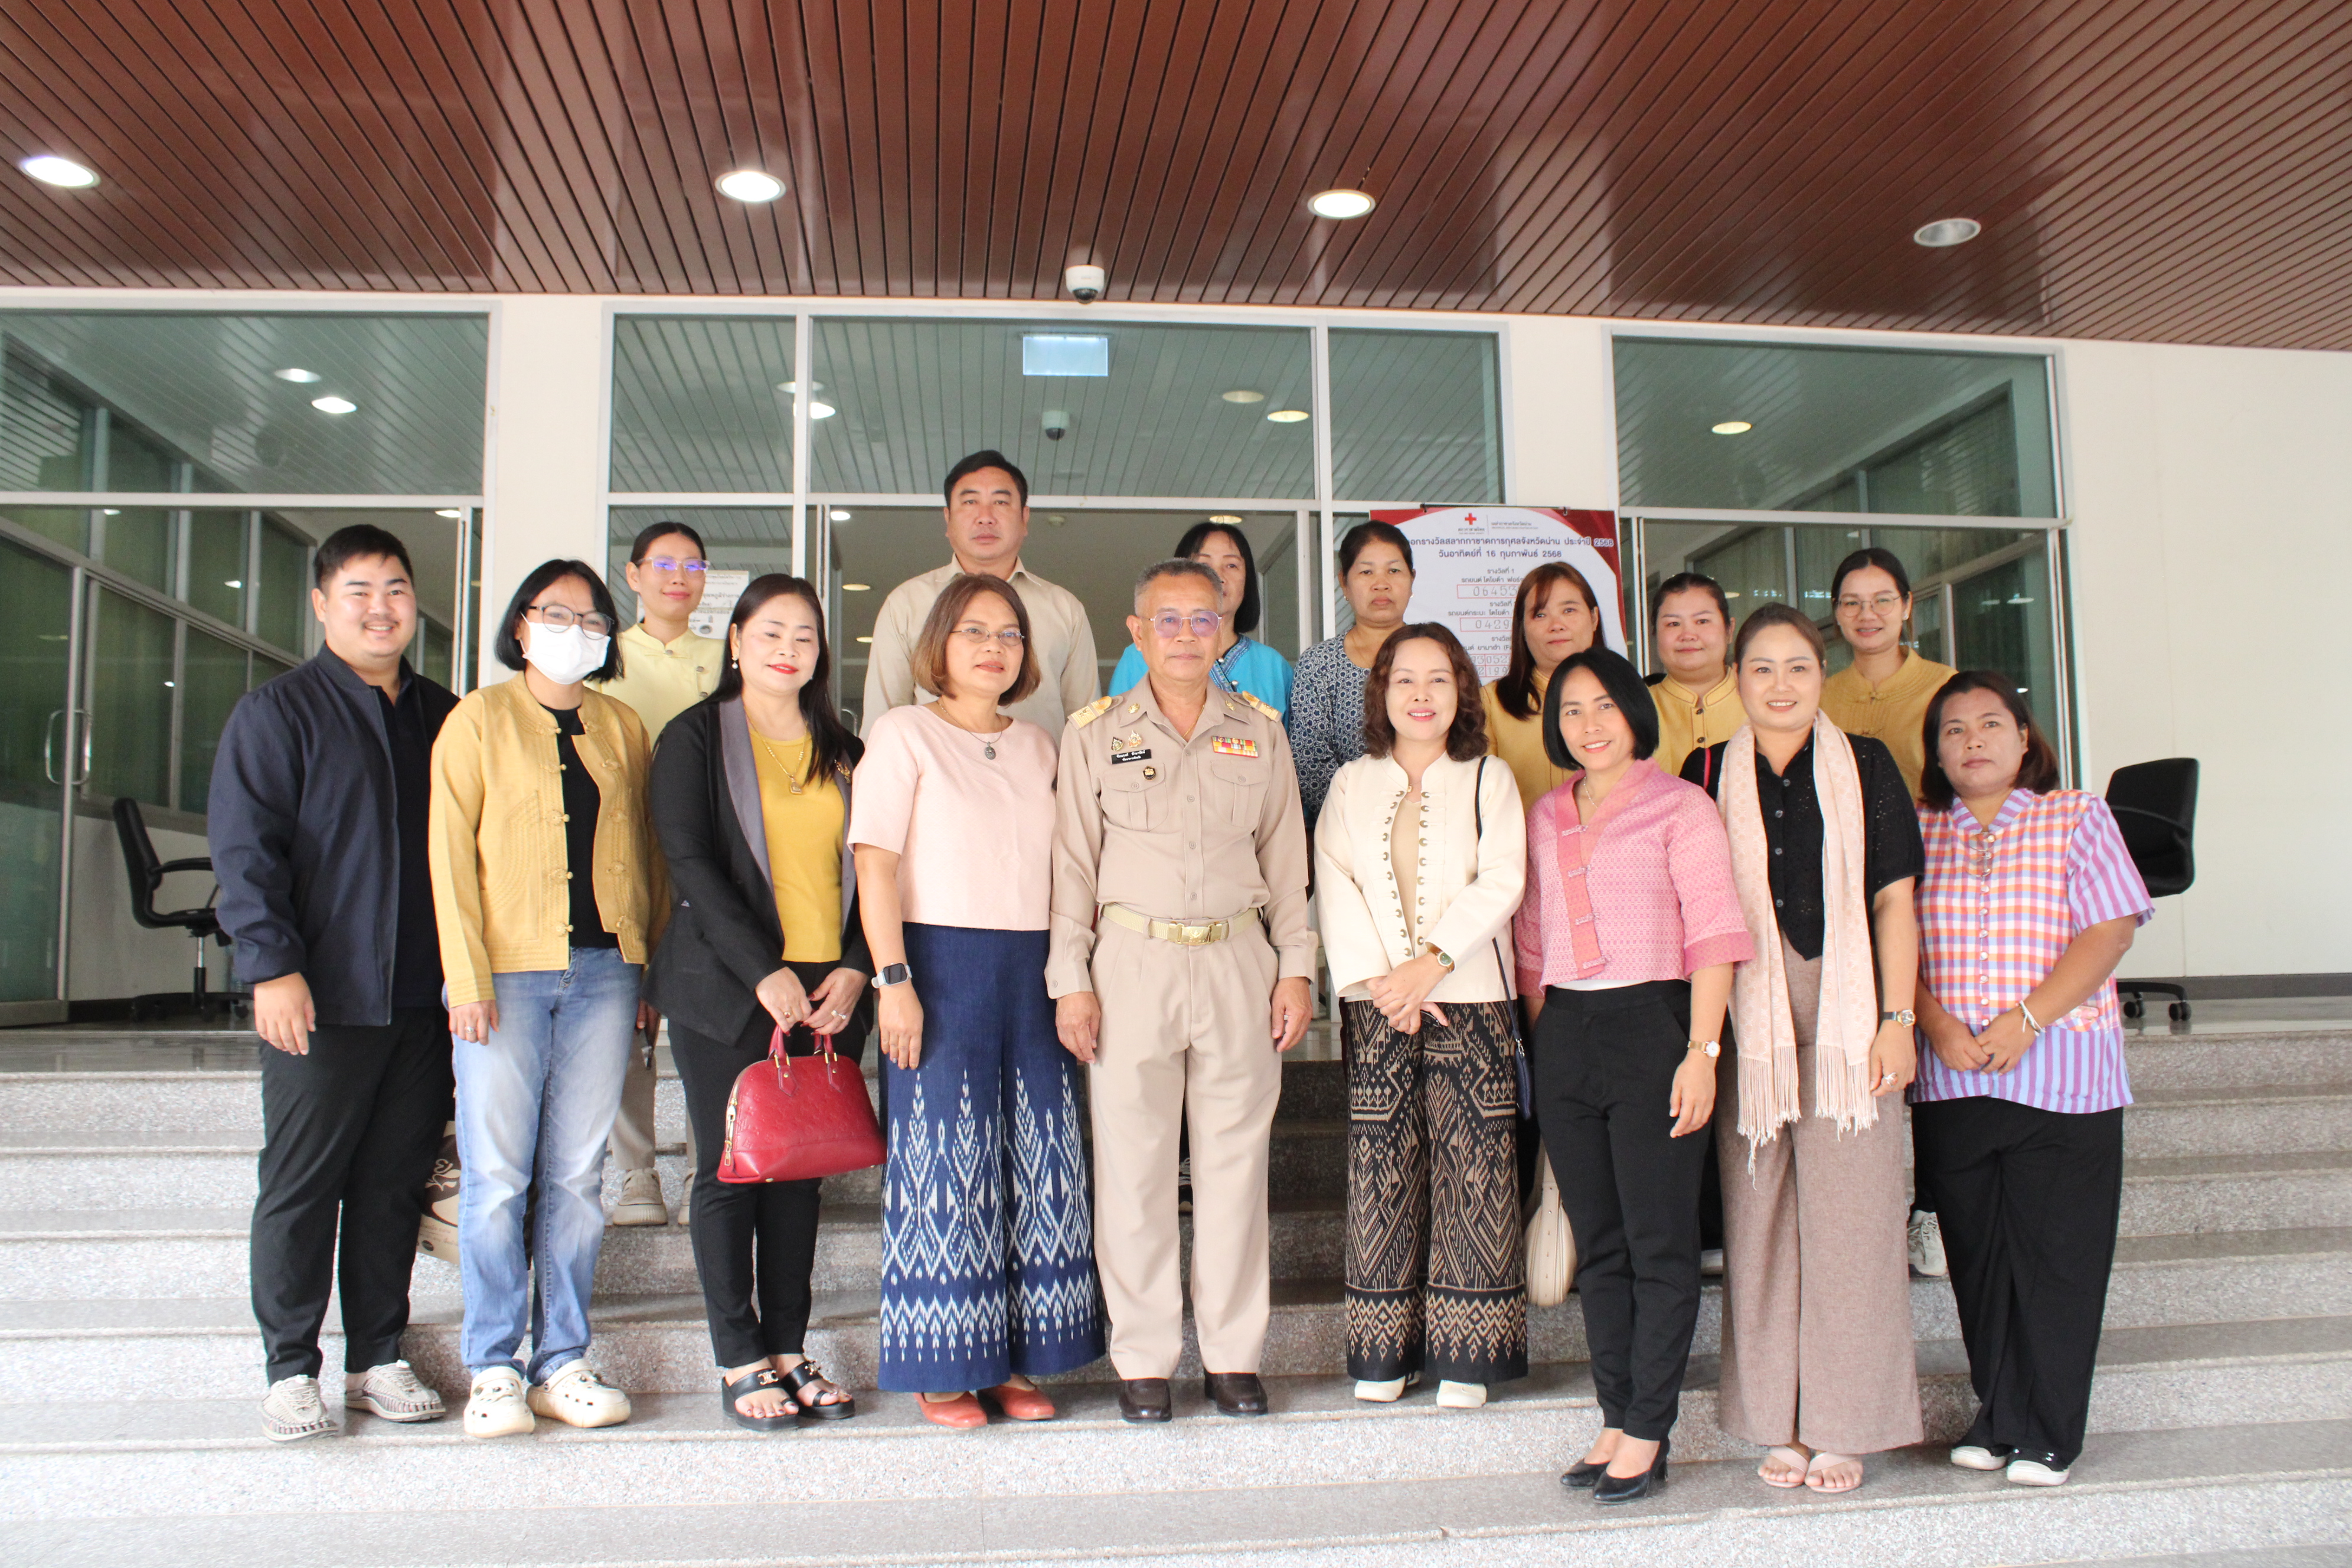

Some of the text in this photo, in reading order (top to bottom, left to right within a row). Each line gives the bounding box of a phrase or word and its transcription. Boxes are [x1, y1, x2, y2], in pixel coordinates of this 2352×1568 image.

[1410, 537, 1560, 547] อกรางวัลสลากกาชาดการกุศลจังหวัดน่าน
[1564, 537, 1590, 545] ประจำปี
[1439, 547, 1482, 557] วันอาทิตย์ที่
[1500, 548, 1538, 560] กุมภาพันธ์
[1473, 585, 1518, 596] 06453
